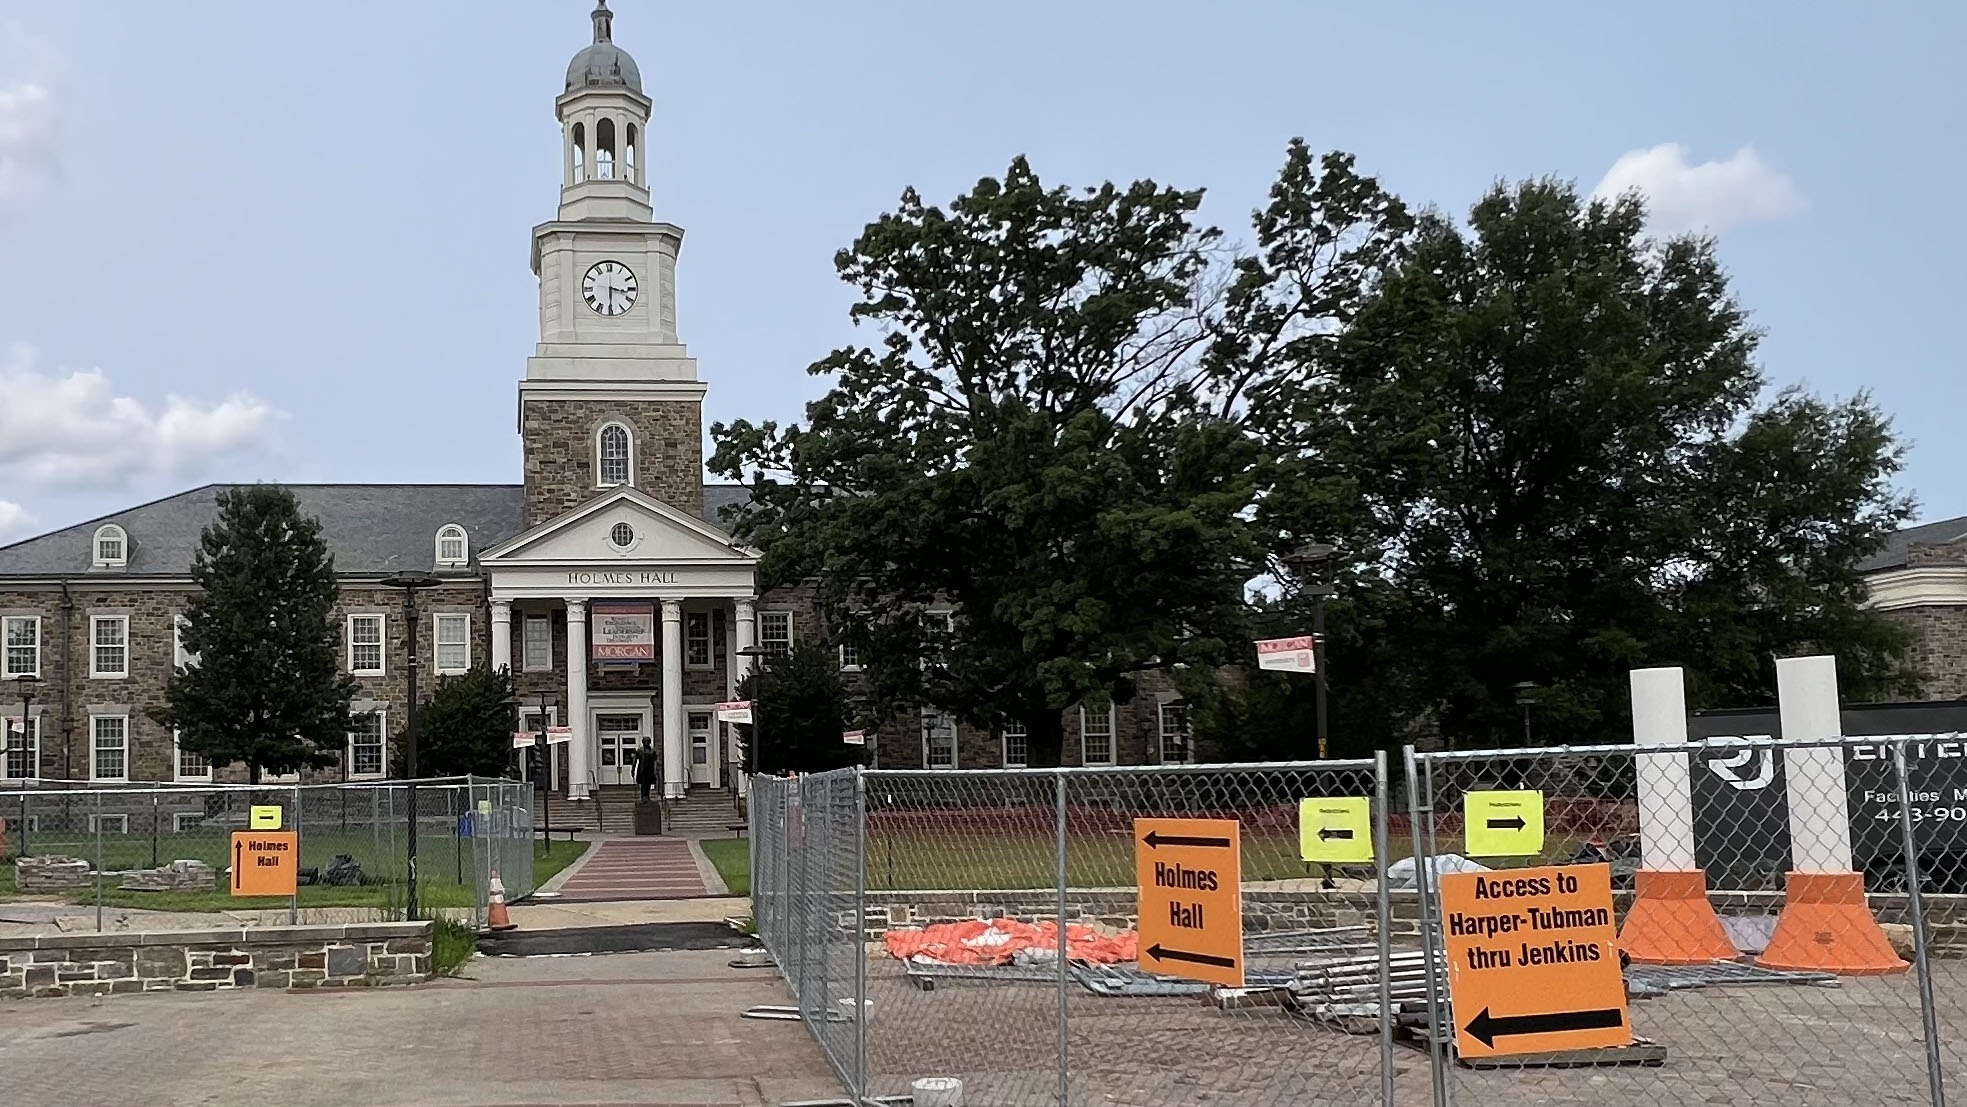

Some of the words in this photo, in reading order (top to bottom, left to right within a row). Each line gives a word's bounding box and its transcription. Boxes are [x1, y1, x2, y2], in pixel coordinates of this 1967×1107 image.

[568, 571, 633, 584] HOLMES
[640, 572, 679, 584] HALL
[597, 646, 650, 657] MORGAN
[248, 840, 289, 851] Holmes
[257, 856, 280, 867] Hall
[1154, 861, 1218, 891] Holmes
[1475, 876, 1551, 899] Access
[1556, 872, 1578, 894] to
[1169, 900, 1204, 929] Hall
[1449, 906, 1609, 938] Harper-Tubman
[1467, 946, 1512, 969] thru
[1518, 940, 1600, 966] Jenkins
